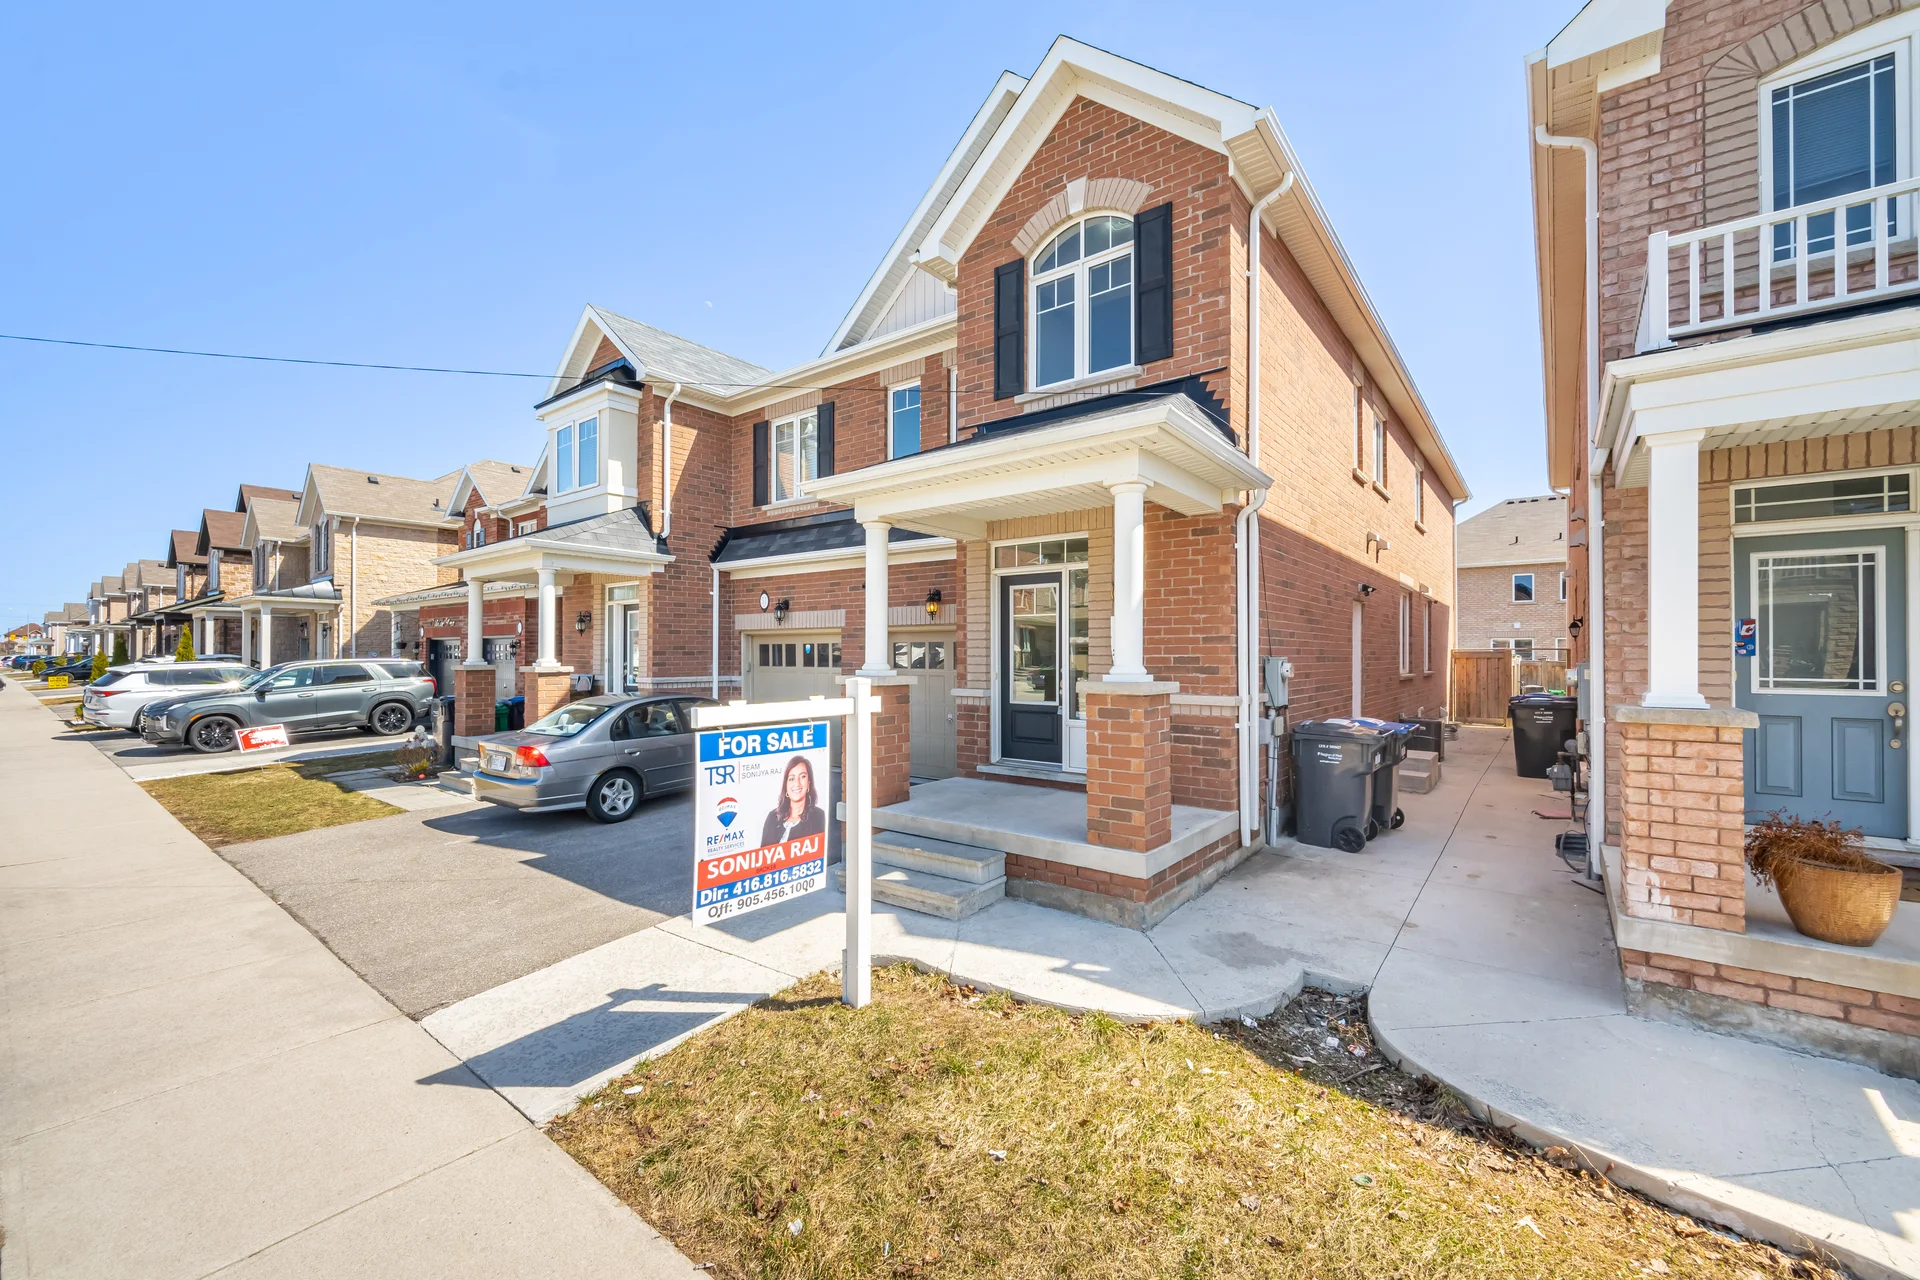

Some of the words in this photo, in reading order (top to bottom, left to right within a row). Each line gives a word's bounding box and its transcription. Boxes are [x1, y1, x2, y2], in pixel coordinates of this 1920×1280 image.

[719, 735, 761, 756] FOR
[767, 730, 814, 751] SALE
[704, 764, 735, 786] TSR
[742, 763, 760, 772] TEAM
[770, 767, 782, 775] RAJ
[707, 830, 744, 846] RE/MAX
[707, 845, 724, 853] REALTY
[724, 841, 745, 850] SERVICES
[707, 846, 785, 879] SONIJYA
[790, 837, 819, 859] RAJ
[756, 864, 777, 874] BROKER
[700, 887, 729, 906] Dir:
[733, 860, 821, 895] 416.816.5832
[708, 902, 732, 918] Off:
[737, 878, 814, 909] 905.456.1000
